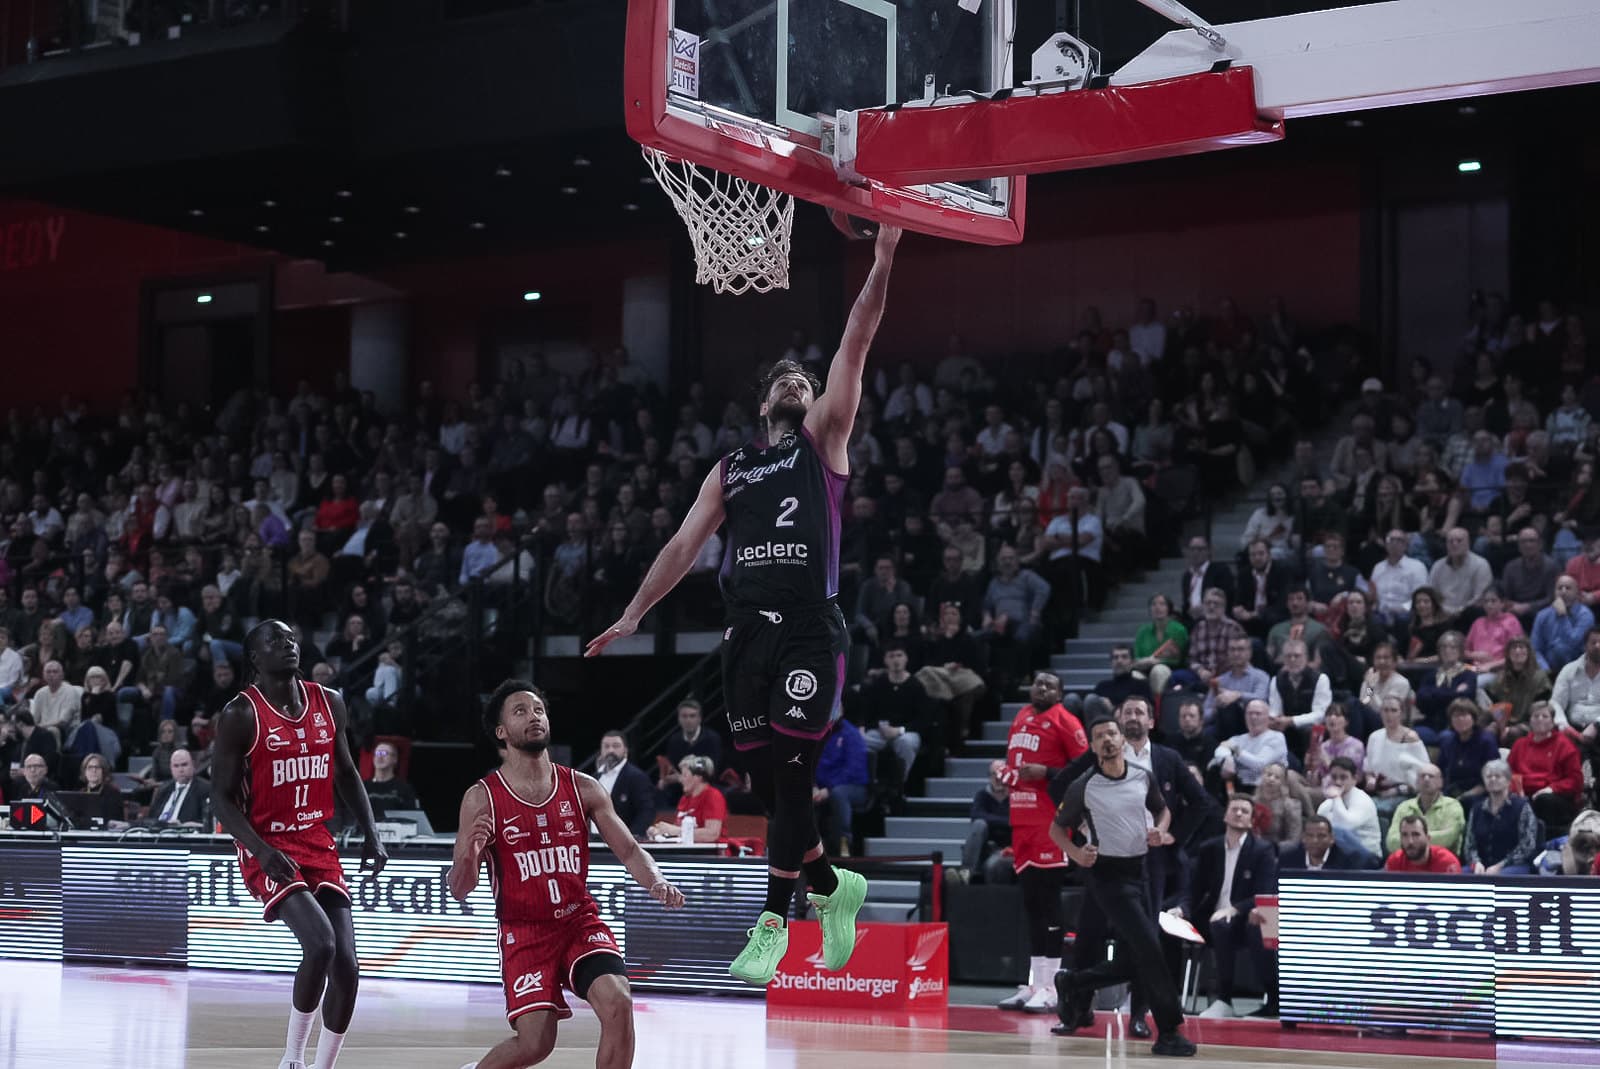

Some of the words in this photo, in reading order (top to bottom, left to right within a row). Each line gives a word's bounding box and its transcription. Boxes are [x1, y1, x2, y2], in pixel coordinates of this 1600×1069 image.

[775, 497, 799, 527] 2
[736, 541, 808, 564] Leclerc
[272, 753, 330, 787] BOURG
[294, 784, 309, 808] 11
[296, 809, 323, 822] Charles
[513, 845, 581, 882] BOURG
[547, 879, 562, 904] 0
[770, 971, 899, 998] Streichenberger
